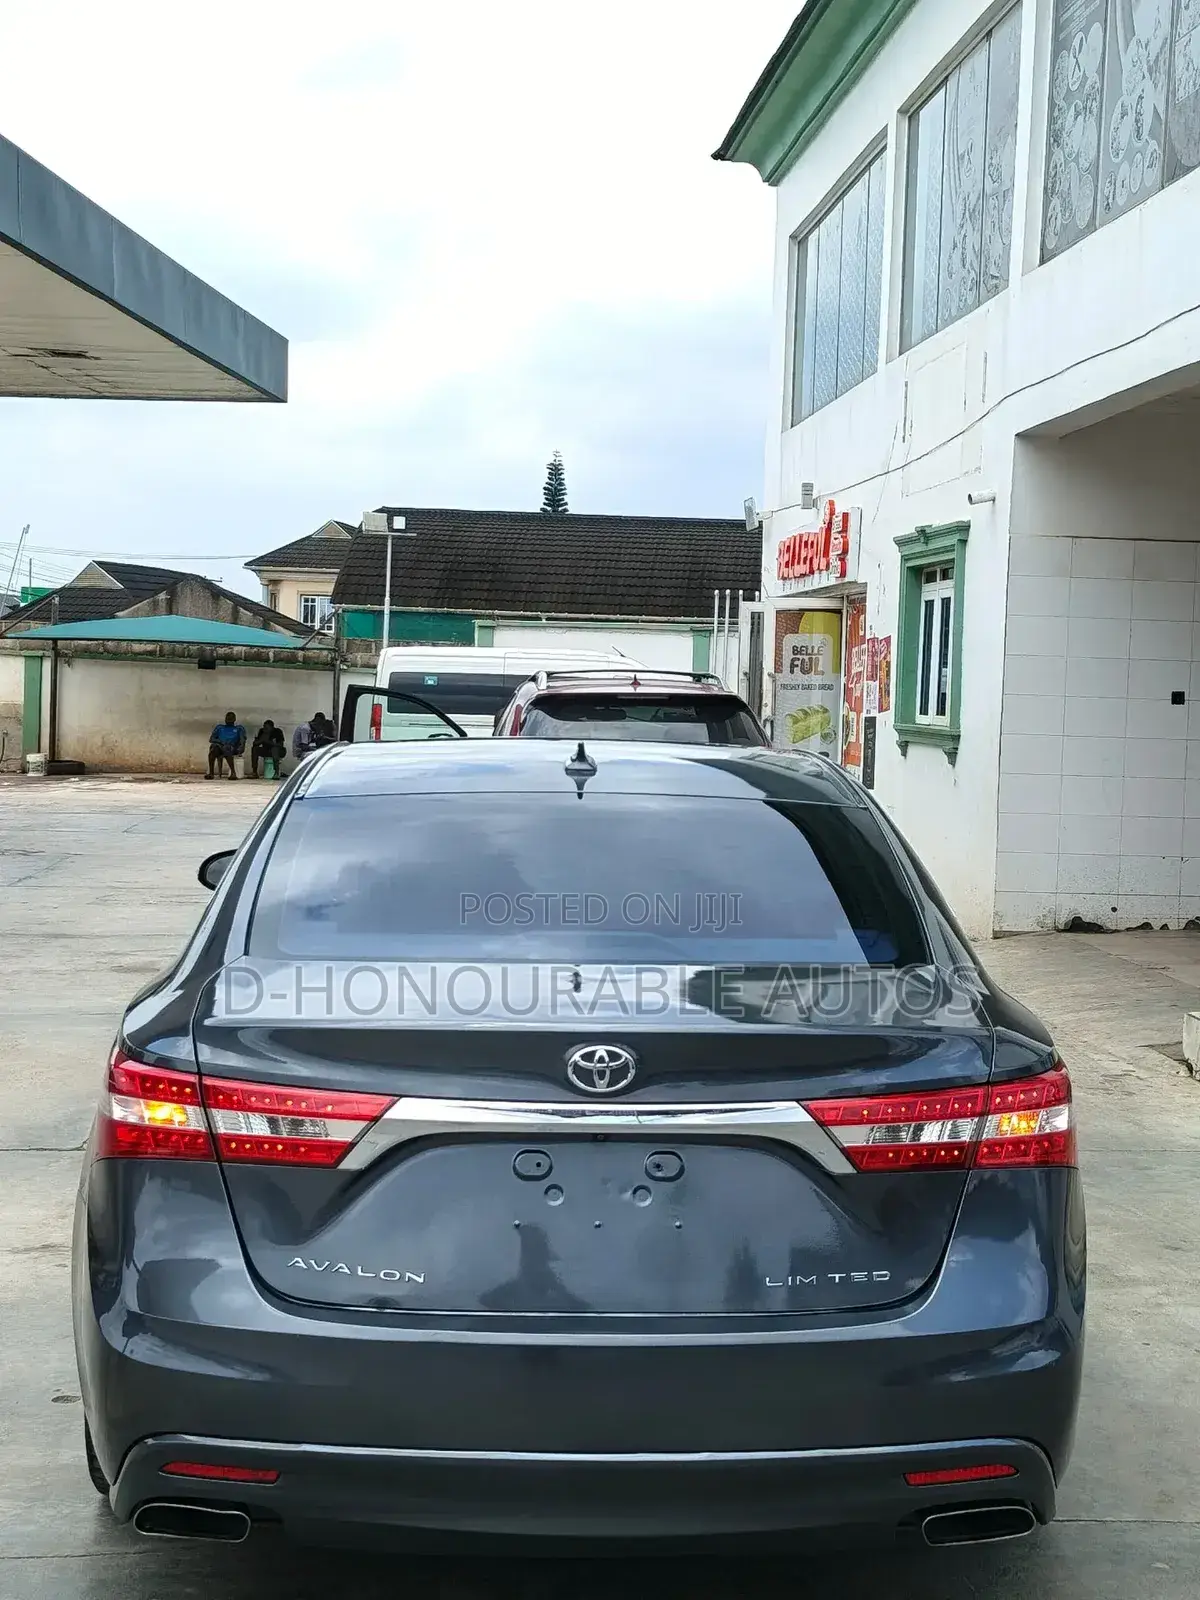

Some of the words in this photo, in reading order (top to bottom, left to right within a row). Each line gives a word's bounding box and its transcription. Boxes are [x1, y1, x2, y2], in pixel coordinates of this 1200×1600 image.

[792, 645, 824, 656] BELLE
[790, 657, 825, 675] FUL
[287, 1257, 426, 1284] AVALON
[765, 1270, 891, 1287] LIMTED
